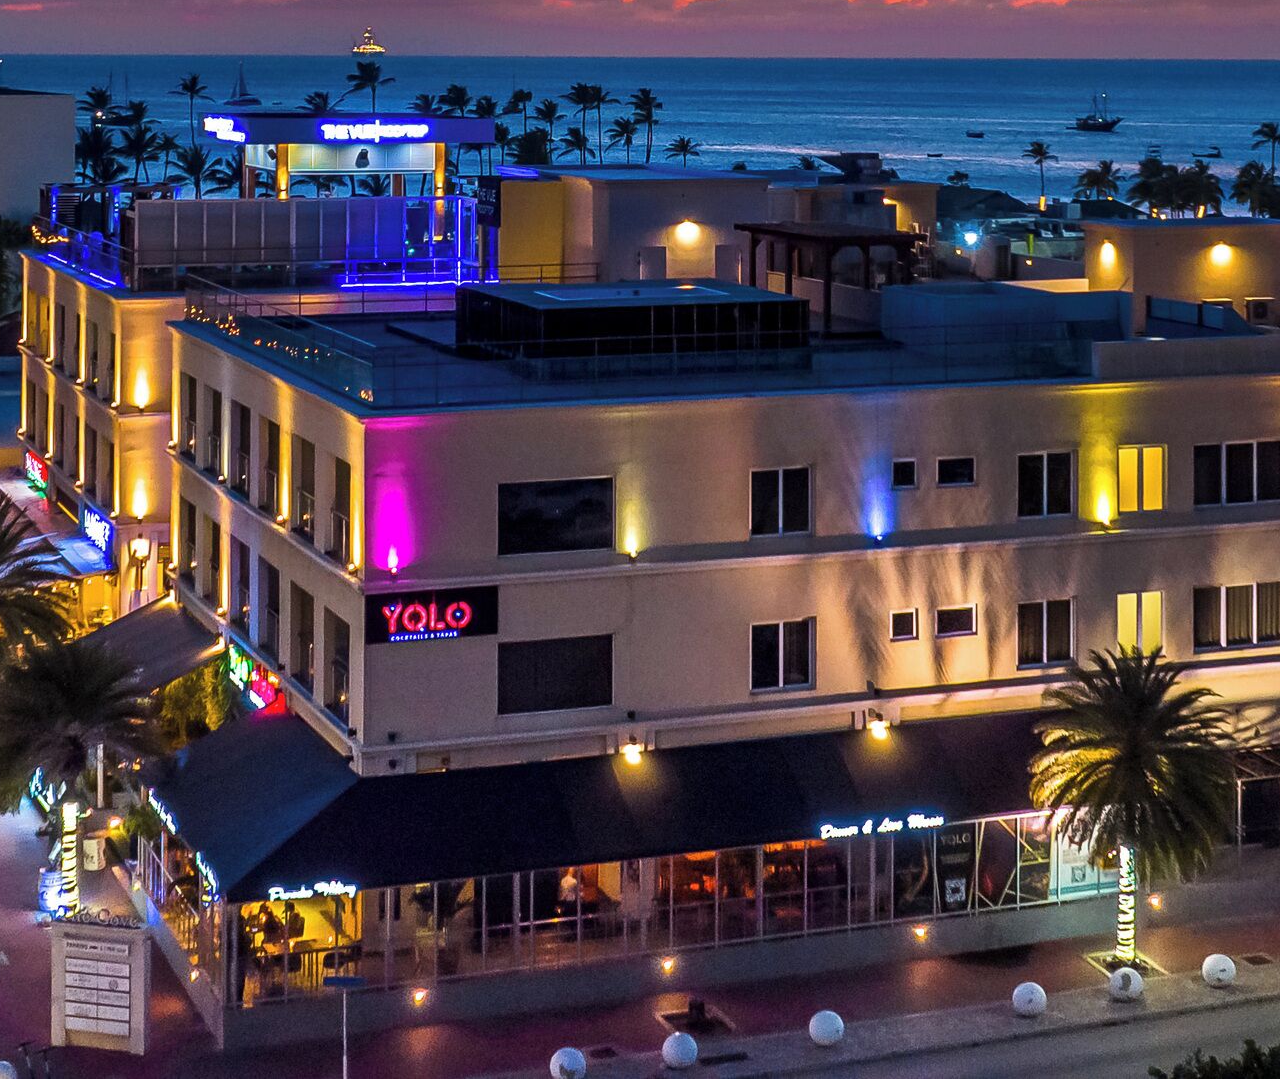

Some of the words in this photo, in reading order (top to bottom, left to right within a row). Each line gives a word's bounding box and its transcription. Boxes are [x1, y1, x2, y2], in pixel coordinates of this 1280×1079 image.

[321, 124, 349, 139] THE
[349, 124, 375, 139] VUE
[382, 602, 472, 633] YOLO
[390, 633, 428, 642] COCKTAILS
[436, 631, 458, 639] TAPAS
